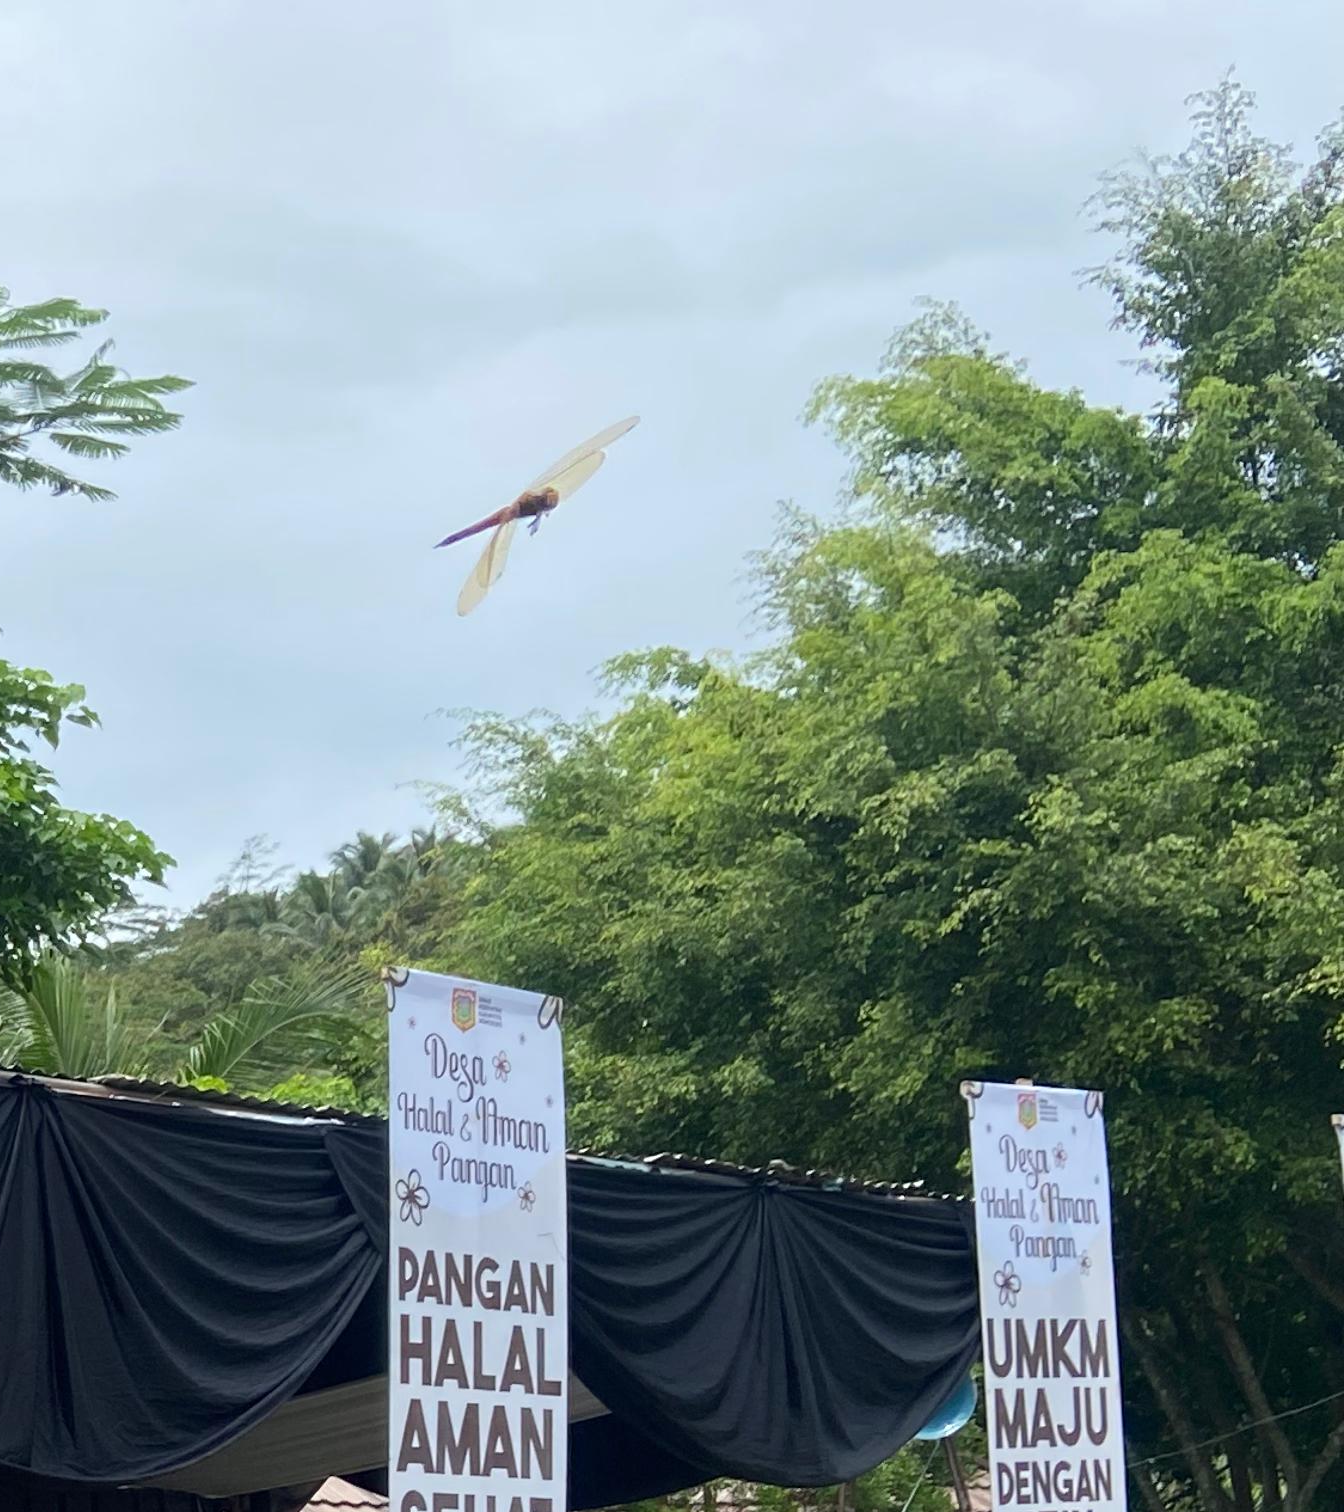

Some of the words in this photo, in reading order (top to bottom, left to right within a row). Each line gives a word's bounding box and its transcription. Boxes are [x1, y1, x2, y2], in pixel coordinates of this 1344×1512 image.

[424, 1032, 487, 1103] Desa
[397, 1092, 454, 1137] Halal
[475, 1096, 550, 1154] Aman
[432, 1141, 517, 1203] Pangan
[999, 1134, 1050, 1190] Desa
[1040, 1182, 1099, 1224] Aman
[1009, 1224, 1076, 1272] Pangan
[398, 1246, 554, 1316] PANGAN
[400, 1314, 562, 1396] HALAL
[987, 1318, 1110, 1378] UMKM
[396, 1398, 553, 1480] AMAN
[995, 1386, 1108, 1449] MAJU
[996, 1459, 1112, 1505] DENGAN
